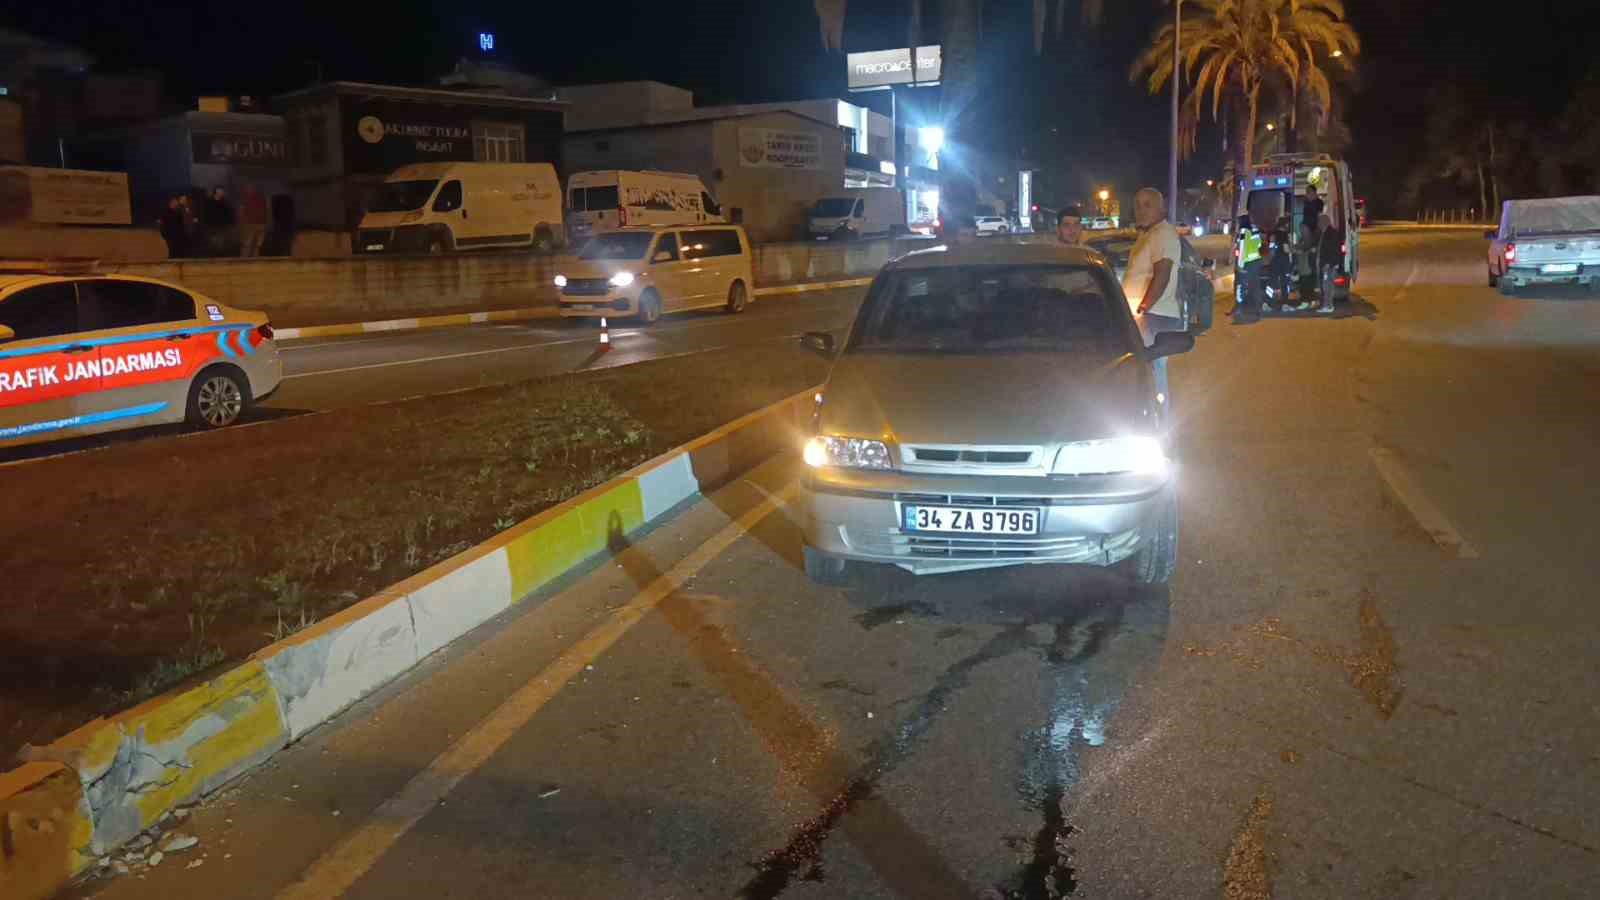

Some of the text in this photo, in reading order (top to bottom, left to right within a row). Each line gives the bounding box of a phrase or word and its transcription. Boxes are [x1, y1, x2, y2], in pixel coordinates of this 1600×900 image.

[63, 348, 182, 382] JANDARMASI
[918, 509, 942, 528] 34
[951, 510, 975, 530] ZA
[982, 512, 1034, 532] 9796
